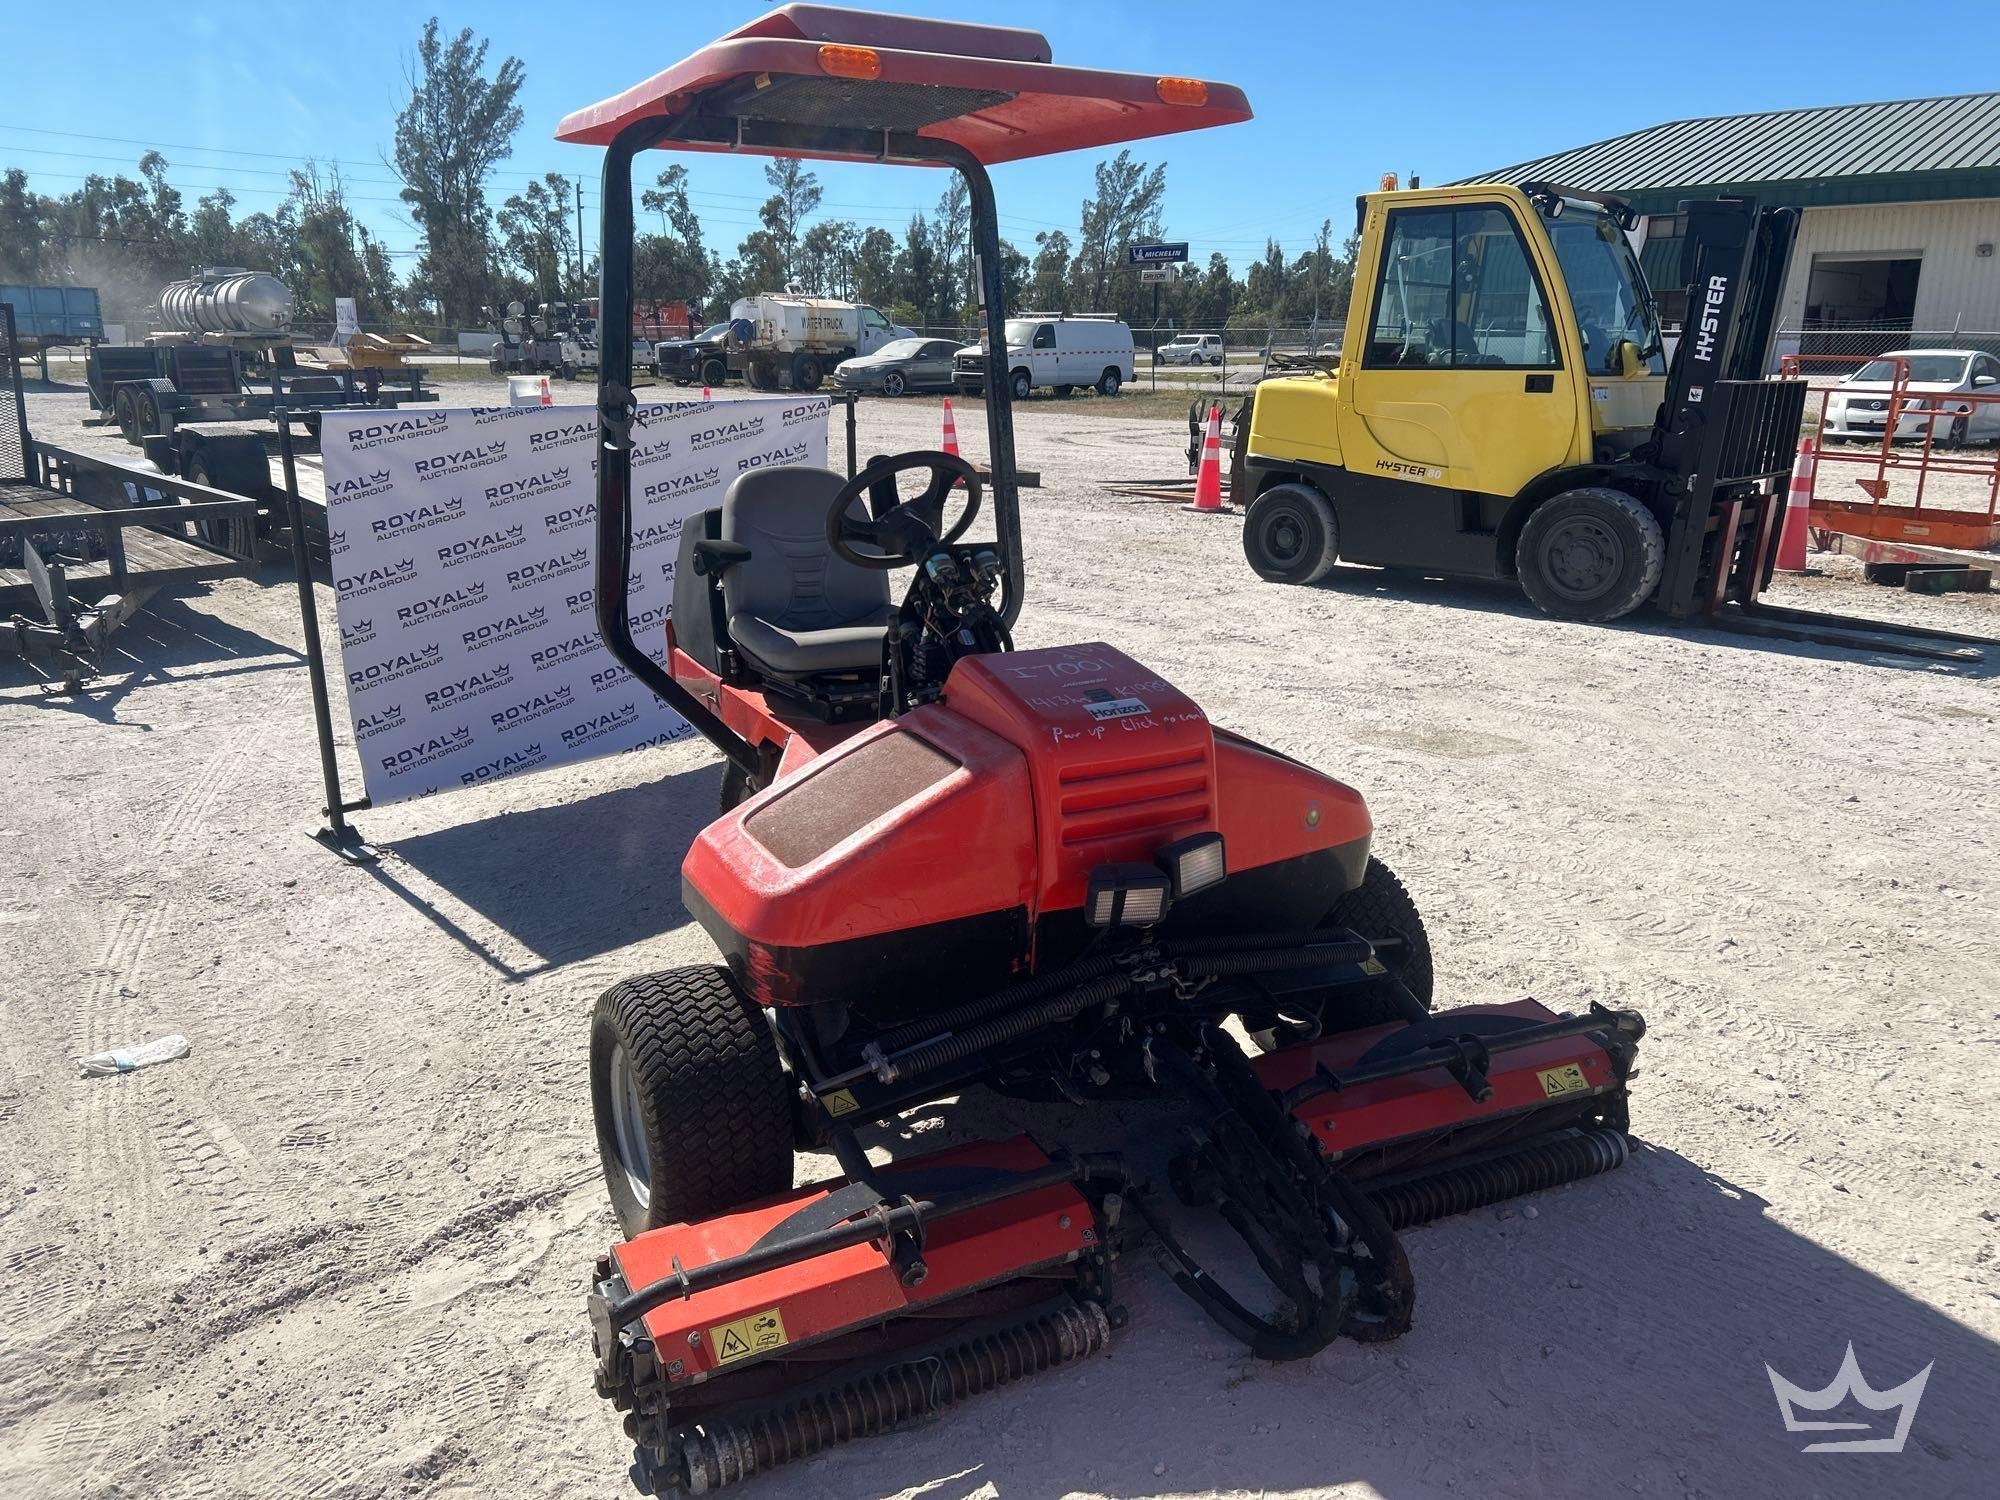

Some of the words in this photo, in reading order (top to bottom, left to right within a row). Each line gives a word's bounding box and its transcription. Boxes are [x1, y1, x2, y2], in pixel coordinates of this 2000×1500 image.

[1145, 250, 1181, 258] MICHELIN
[801, 317, 822, 330] WATER
[823, 318, 844, 330] TRUCK
[1694, 275, 1728, 361] HYSTER
[475, 409, 524, 425] AUCTION
[682, 404, 715, 417] GROUP
[782, 413, 820, 427] AUCTION
[348, 419, 428, 442] ROYAL
[352, 435, 405, 451] AUCTION
[407, 425, 448, 438] GROUP
[530, 422, 598, 445] ROYAL
[690, 422, 749, 444] ROYAL
[691, 437, 732, 452] AUCTION
[733, 428, 765, 442] GROUP
[531, 436, 578, 453] AUCTION
[415, 447, 488, 473] ROYAL
[420, 463, 468, 482] AUCTION
[470, 453, 508, 469] GROUP
[737, 448, 794, 470] ROYAL
[777, 454, 809, 467] GROUP
[1375, 460, 1426, 476] HYSTER
[1427, 469, 1442, 479] 80
[327, 477, 372, 495] YAL
[353, 483, 393, 500] GROUP
[485, 474, 552, 500] ROYAL
[489, 490, 535, 508] AUCTION
[536, 480, 572, 494] GROUP
[644, 472, 705, 497] ROYAL
[647, 489, 688, 505] AUCTION
[689, 479, 721, 493] GROUP
[371, 505, 445, 533] ROYAL
[376, 522, 426, 542] AUCTION
[427, 511, 466, 527] GROUP
[545, 503, 598, 527] ROYA
[548, 517, 592, 535] AUCTION
[438, 531, 507, 560] ROYAL
[630, 541, 653, 552] TION
[631, 525, 668, 543] YAL
[442, 549, 489, 568] AUCTION
[490, 537, 527, 553] GROUP
[337, 566, 397, 591] OYAL
[379, 571, 418, 588] GROUP
[506, 555, 572, 583] ROYAL
[511, 572, 555, 591] AUCTION
[556, 560, 590, 577] GROUP
[397, 590, 468, 620] ROYAL
[402, 607, 450, 629] AUCTION
[451, 595, 489, 612] GROUP
[570, 602, 596, 615] AUCT
[629, 604, 673, 628] ROYA
[462, 614, 529, 645] ROYAL
[467, 631, 513, 653] AUCTION
[513, 618, 549, 635] GROUP
[632, 619, 667, 636] AUCTIO
[531, 634, 594, 664] ROYAL
[536, 651, 579, 672] AUCTION
[579, 642, 607, 655] GROU
[348, 652, 422, 685] ROYAL
[354, 671, 404, 694] AUCTION
[405, 656, 444, 674] GROUP
[590, 665, 626, 686] ROY
[424, 672, 494, 704] ROYAL
[430, 690, 478, 712] AUCTION
[478, 676, 514, 694] GROUP
[490, 694, 556, 726] ROYAL
[497, 711, 542, 733] AUCTION
[542, 697, 575, 715] GROUP
[1091, 703, 1149, 719] Horizon
[368, 718, 406, 737] GROUP
[560, 711, 622, 742] ROYAL
[567, 729, 608, 749] AUCTION
[608, 714, 640, 732] GROUP
[381, 735, 454, 770] ROYAL
[389, 754, 437, 778] AUCTION
[437, 738, 475, 757] GROUP
[513, 754, 547, 773] GROUP
[460, 752, 527, 785] ROYAL
